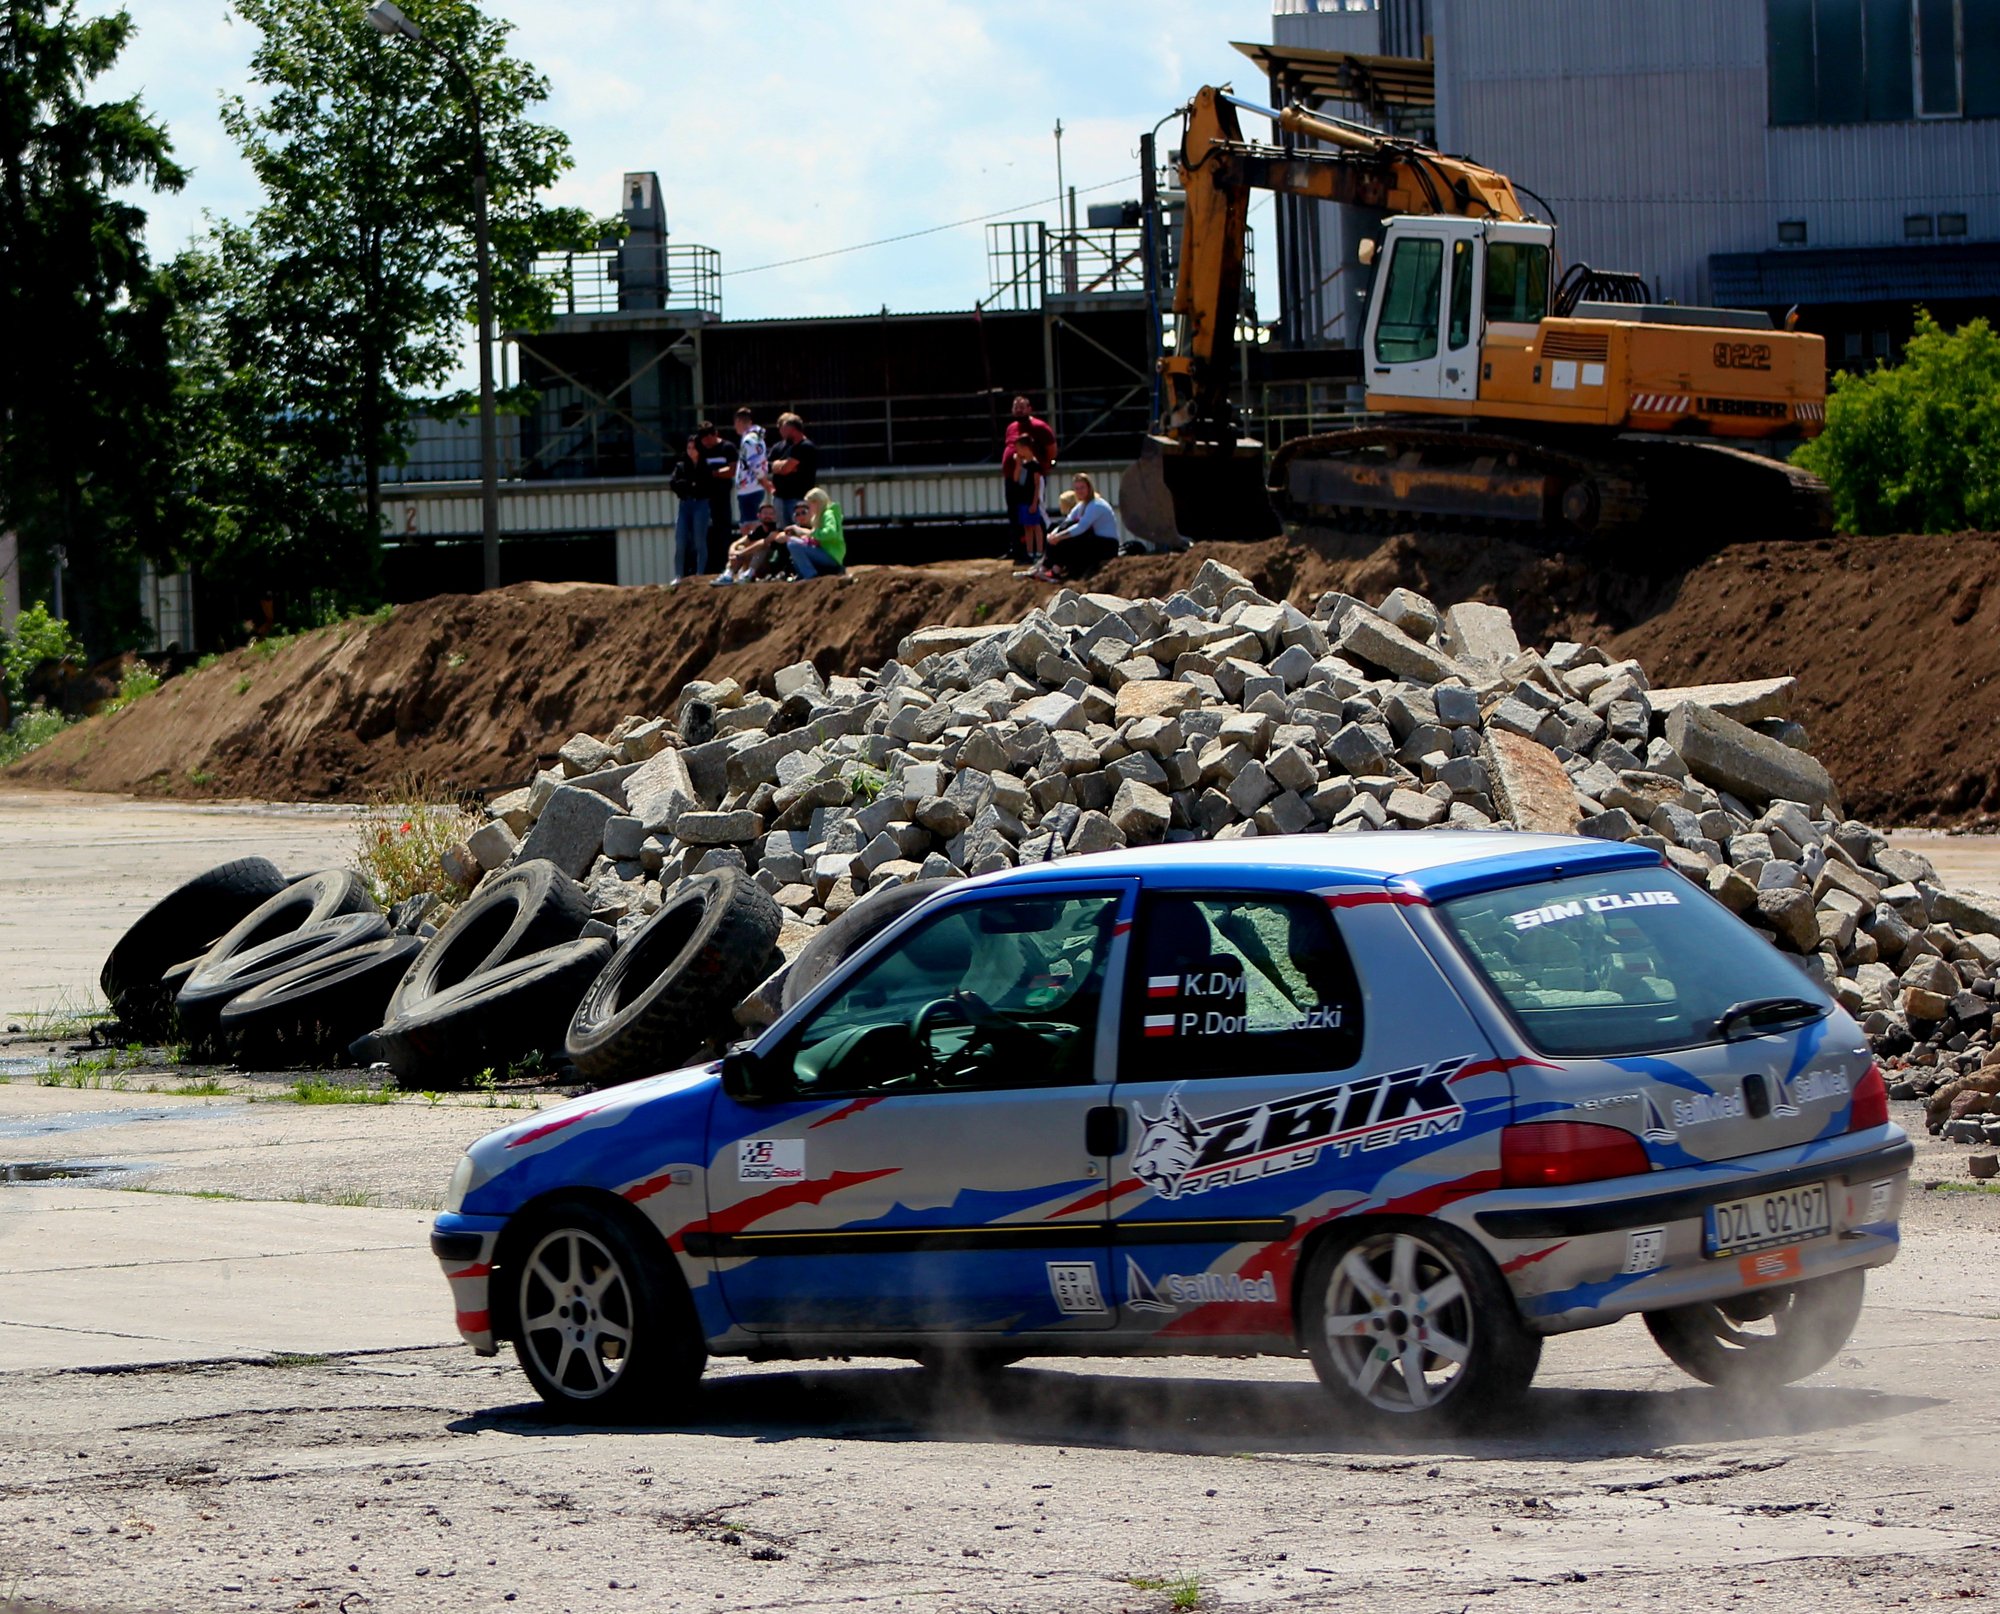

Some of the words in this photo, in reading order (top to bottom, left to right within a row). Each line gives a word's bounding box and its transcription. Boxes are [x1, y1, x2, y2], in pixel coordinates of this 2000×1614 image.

[1713, 342, 1772, 371] 922
[1696, 396, 1788, 418] LIEBHERR
[1510, 900, 1585, 931] SIM
[1584, 890, 1681, 912] CLUB
[1175, 1148, 1323, 1198] RALLY
[1333, 1110, 1466, 1158] TEAM
[1717, 1203, 1760, 1244] DZL
[1166, 1270, 1277, 1303] SailMed
